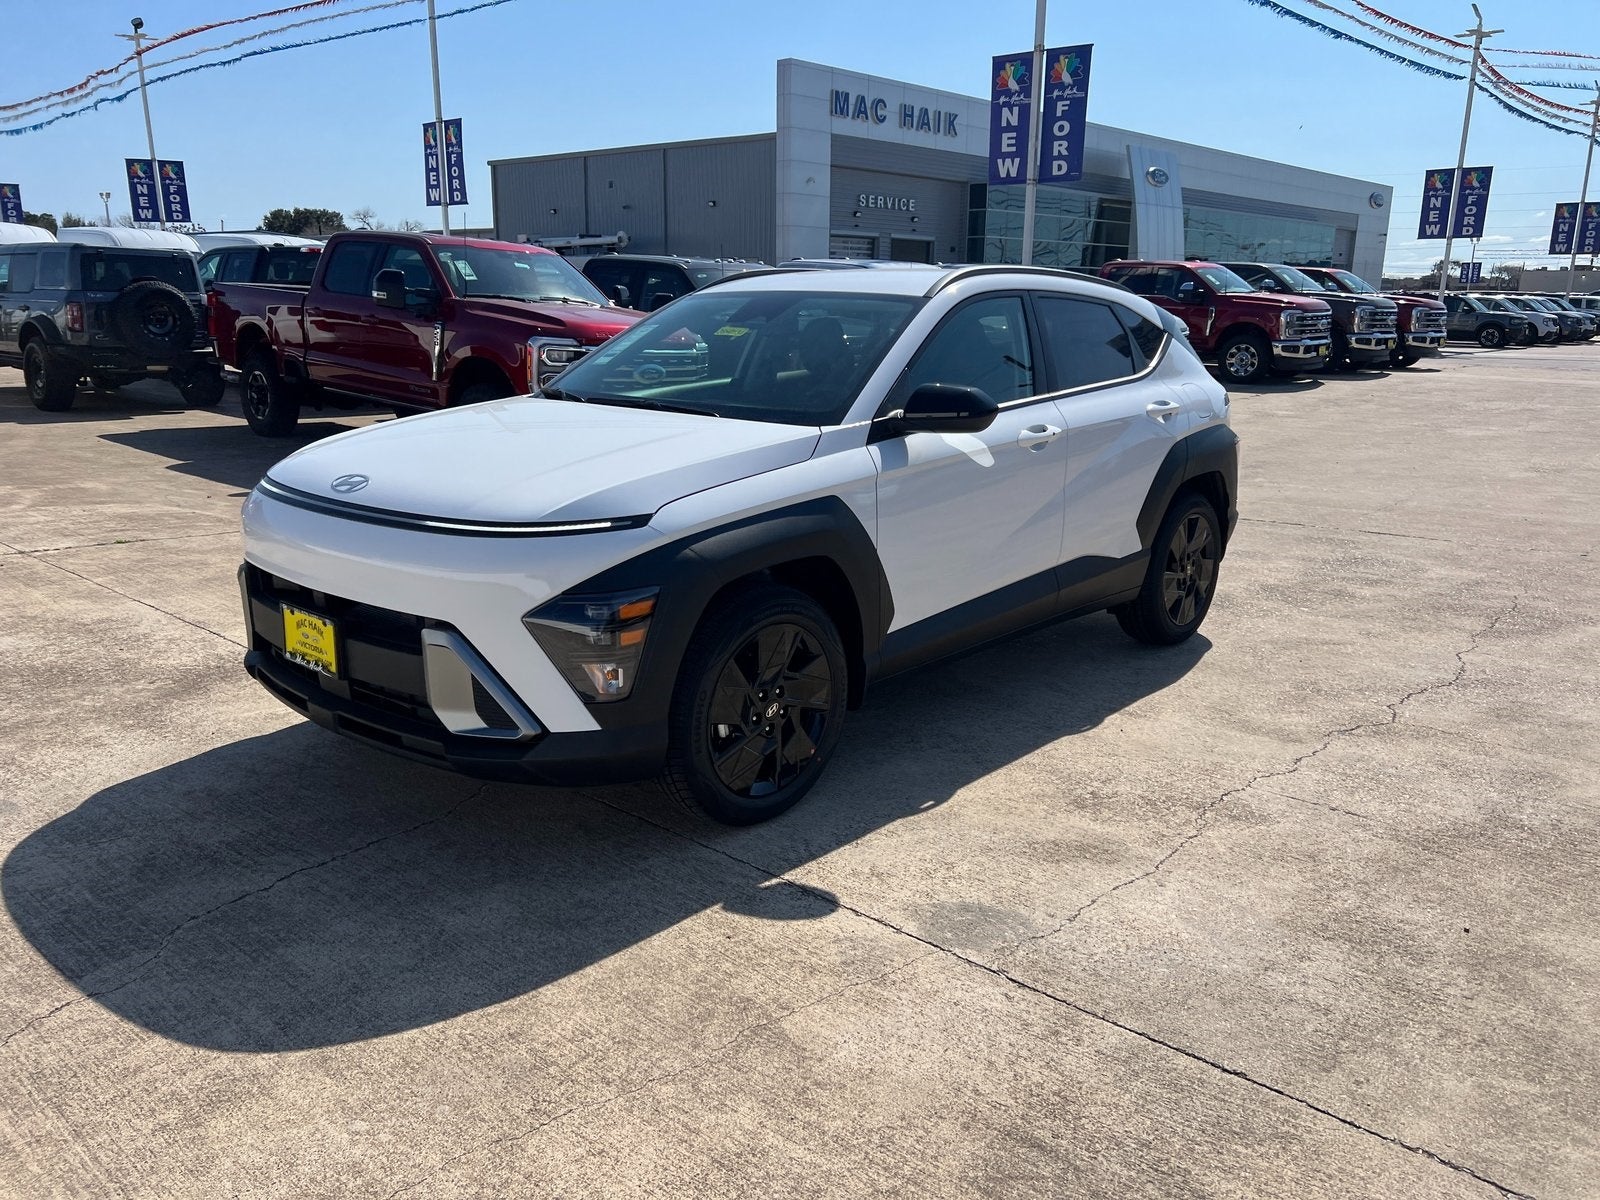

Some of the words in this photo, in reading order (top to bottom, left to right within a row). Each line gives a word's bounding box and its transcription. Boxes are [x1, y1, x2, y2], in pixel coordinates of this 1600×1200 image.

[831, 89, 887, 125] MAC
[899, 103, 959, 137] HAIK
[997, 106, 1021, 178] NEW
[1052, 100, 1071, 176] FORD
[428, 155, 440, 202] NEW
[451, 154, 462, 202] FORD
[7, 202, 17, 223] FOR
[136, 184, 153, 219] NEW
[169, 185, 183, 220] FORD
[859, 193, 916, 211] SERVICE
[1425, 196, 1442, 236] NEW
[1462, 195, 1478, 236] FORD
[1555, 223, 1569, 252] NEW
[1584, 222, 1597, 253] FORD
[296, 619, 308, 631] MAC
[308, 620, 325, 640] HAIK
